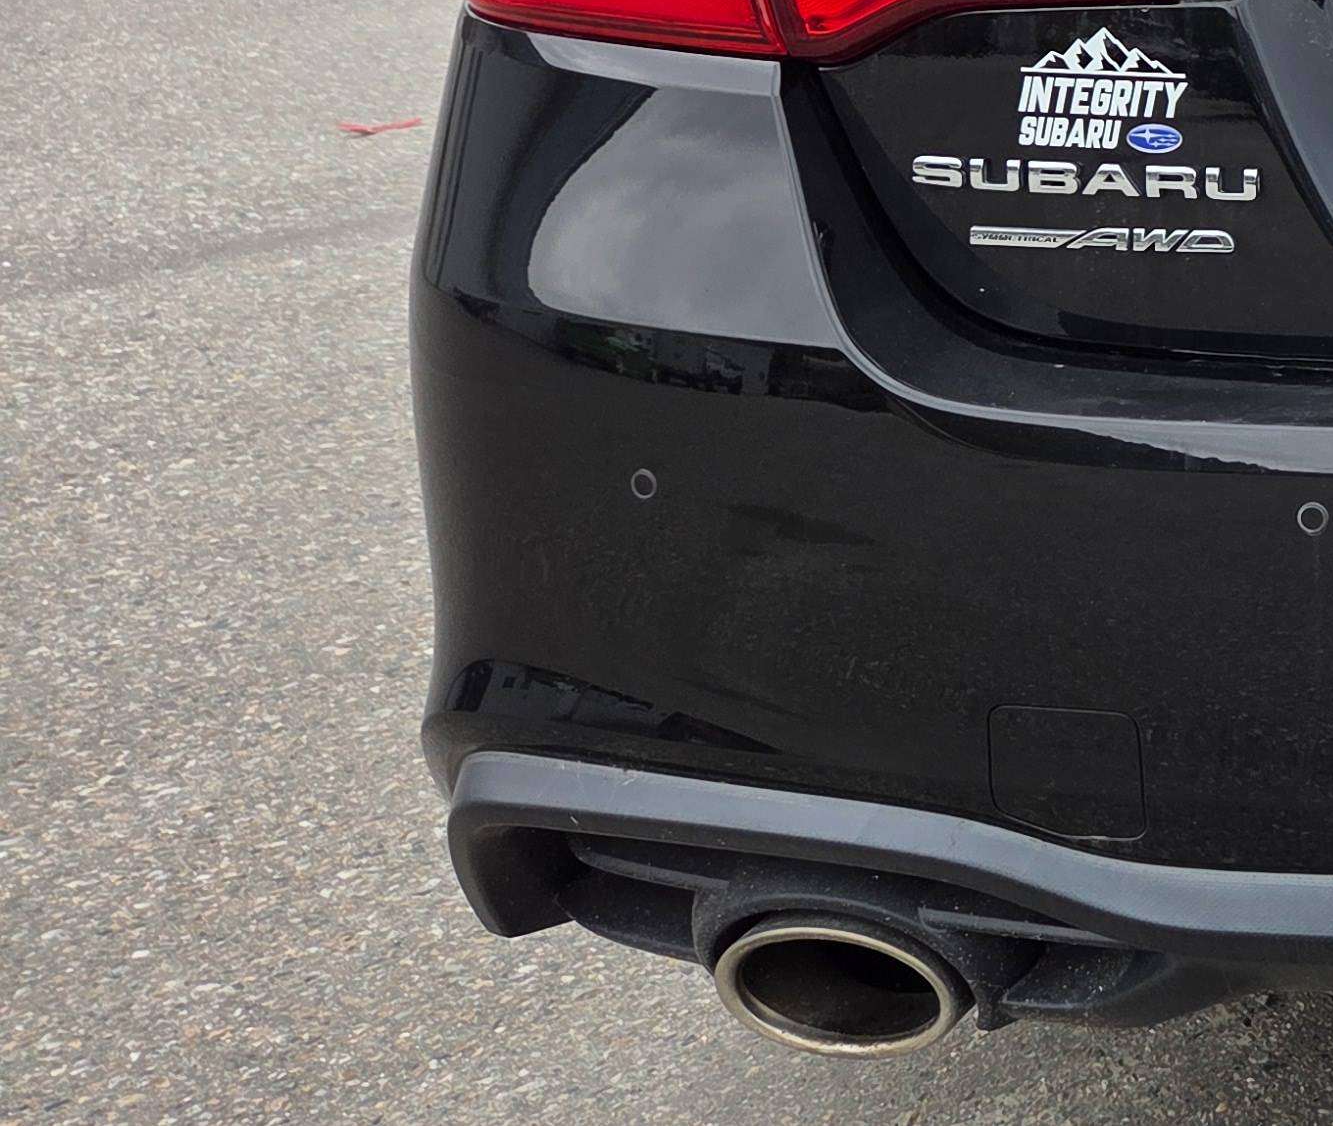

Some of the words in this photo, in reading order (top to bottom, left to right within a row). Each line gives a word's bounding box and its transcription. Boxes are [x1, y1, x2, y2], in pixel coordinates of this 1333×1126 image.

[1018, 76, 1188, 118] INTEGRITY
[1019, 117, 1121, 149] SUBARU
[912, 155, 1261, 202] SUBARU
[1066, 227, 1235, 253] AWD
